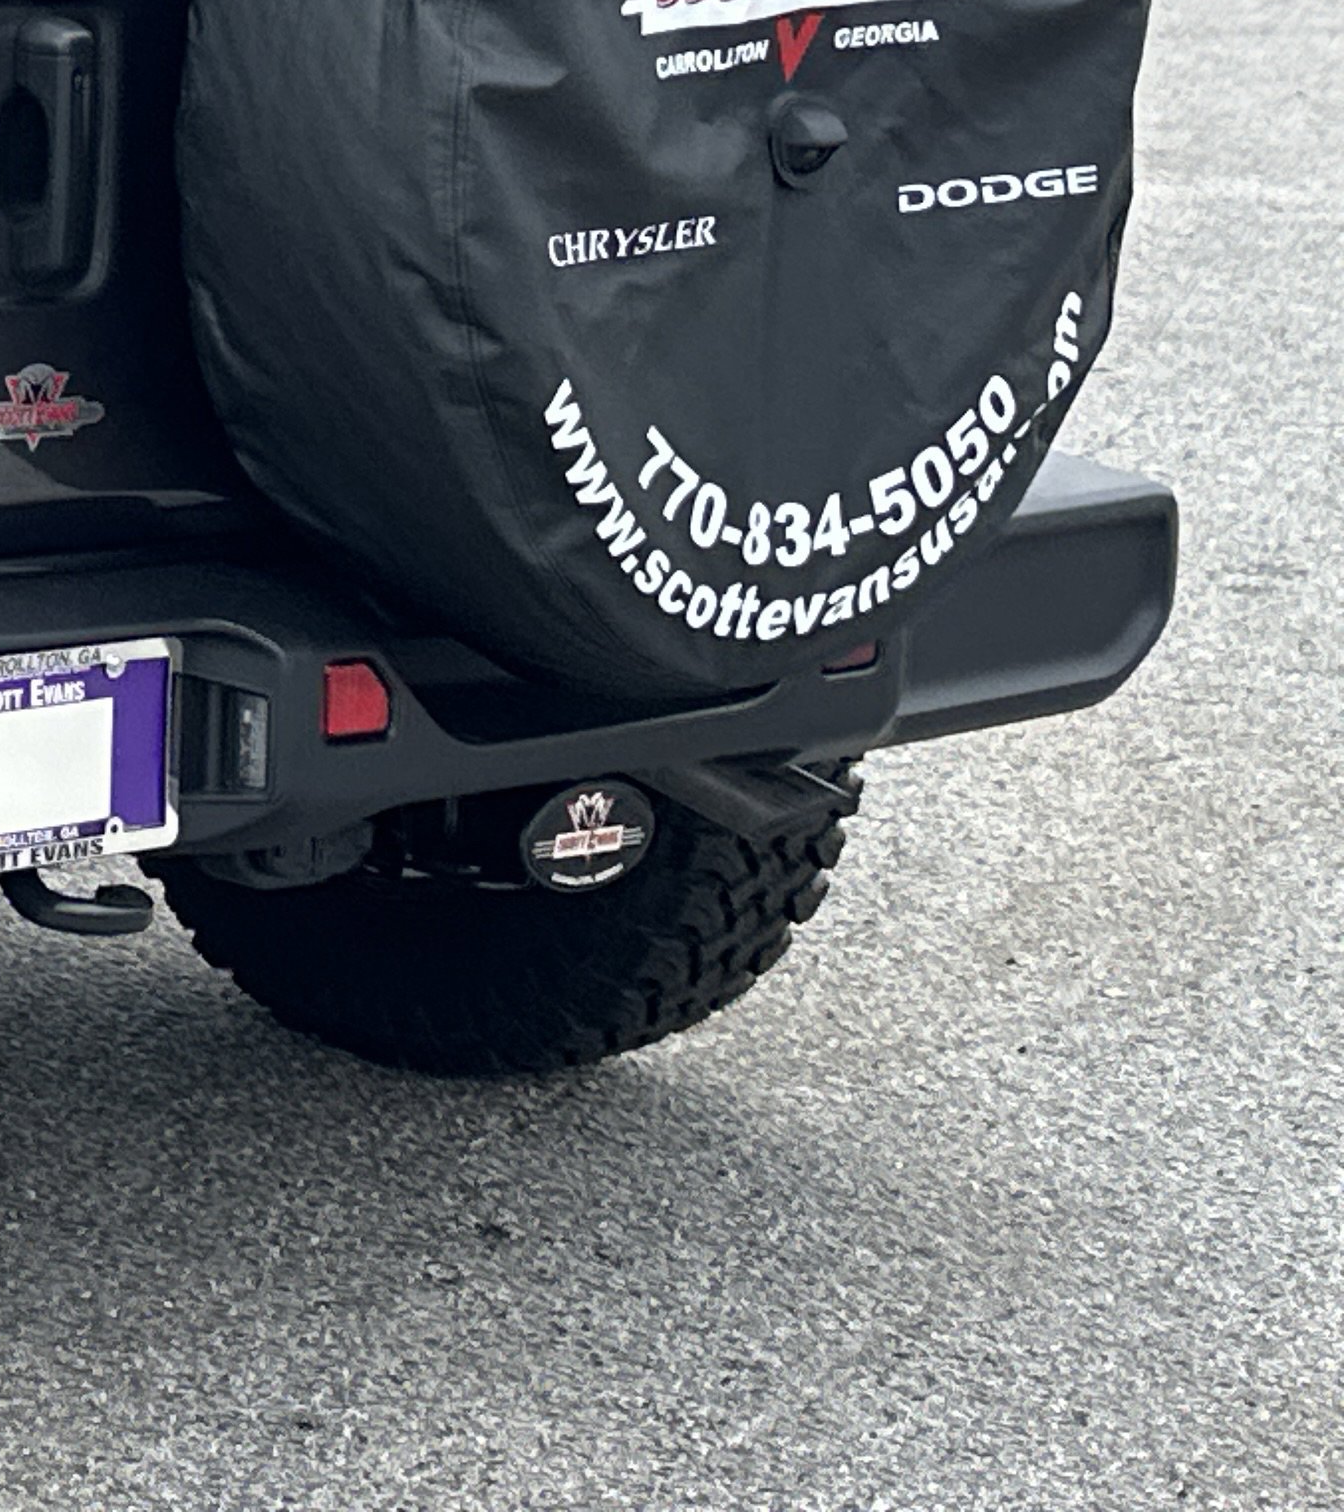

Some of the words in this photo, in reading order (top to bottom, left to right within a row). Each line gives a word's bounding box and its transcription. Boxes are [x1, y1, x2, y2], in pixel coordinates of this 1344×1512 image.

[655, 40, 769, 79] CARROLLTON
[834, 19, 939, 49] GEORGIA
[897, 164, 1099, 214] DODGE
[547, 215, 717, 268] CHRYSLER
[544, 290, 1082, 641] www.scottevansusa.om
[637, 374, 1016, 568] 770-834-5050
[78, 646, 102, 665] GA
[30, 837, 104, 864] EVANS
